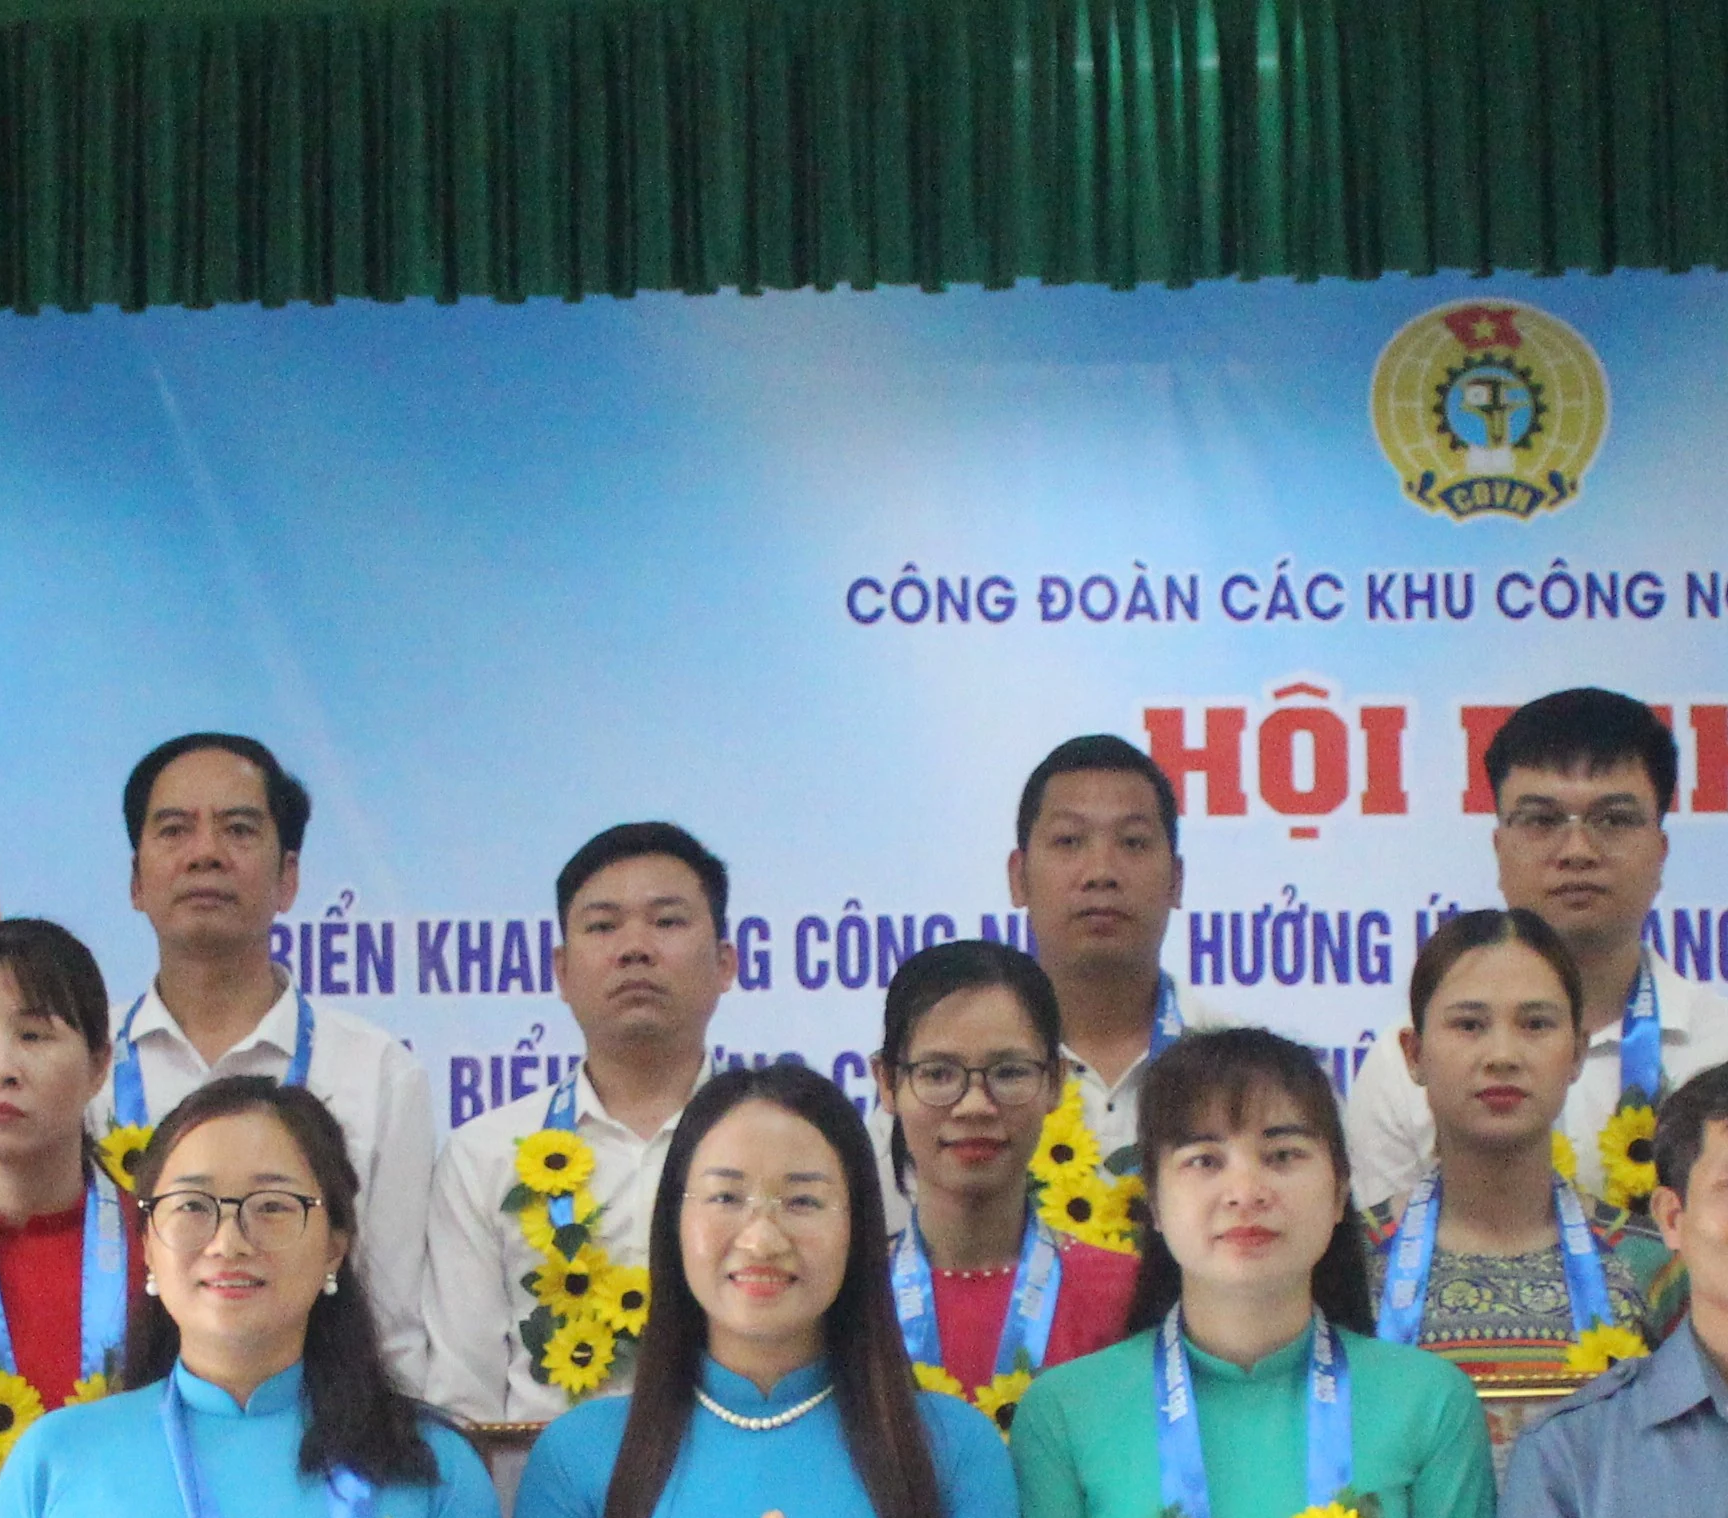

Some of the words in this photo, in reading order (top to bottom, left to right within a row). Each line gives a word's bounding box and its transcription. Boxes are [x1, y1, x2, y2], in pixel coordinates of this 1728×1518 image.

[845, 563, 1015, 625] CÔNG
[1038, 562, 1198, 622] ĐOÀN
[1220, 560, 1343, 621] CÁC
[1366, 572, 1473, 620] KHU
[1495, 557, 1665, 620] CÔNG
[1144, 682, 1408, 840] HỘI
[268, 889, 395, 995] RIỂN
[417, 919, 555, 994] KHAI
[1188, 884, 1392, 986] HƯỞNG
